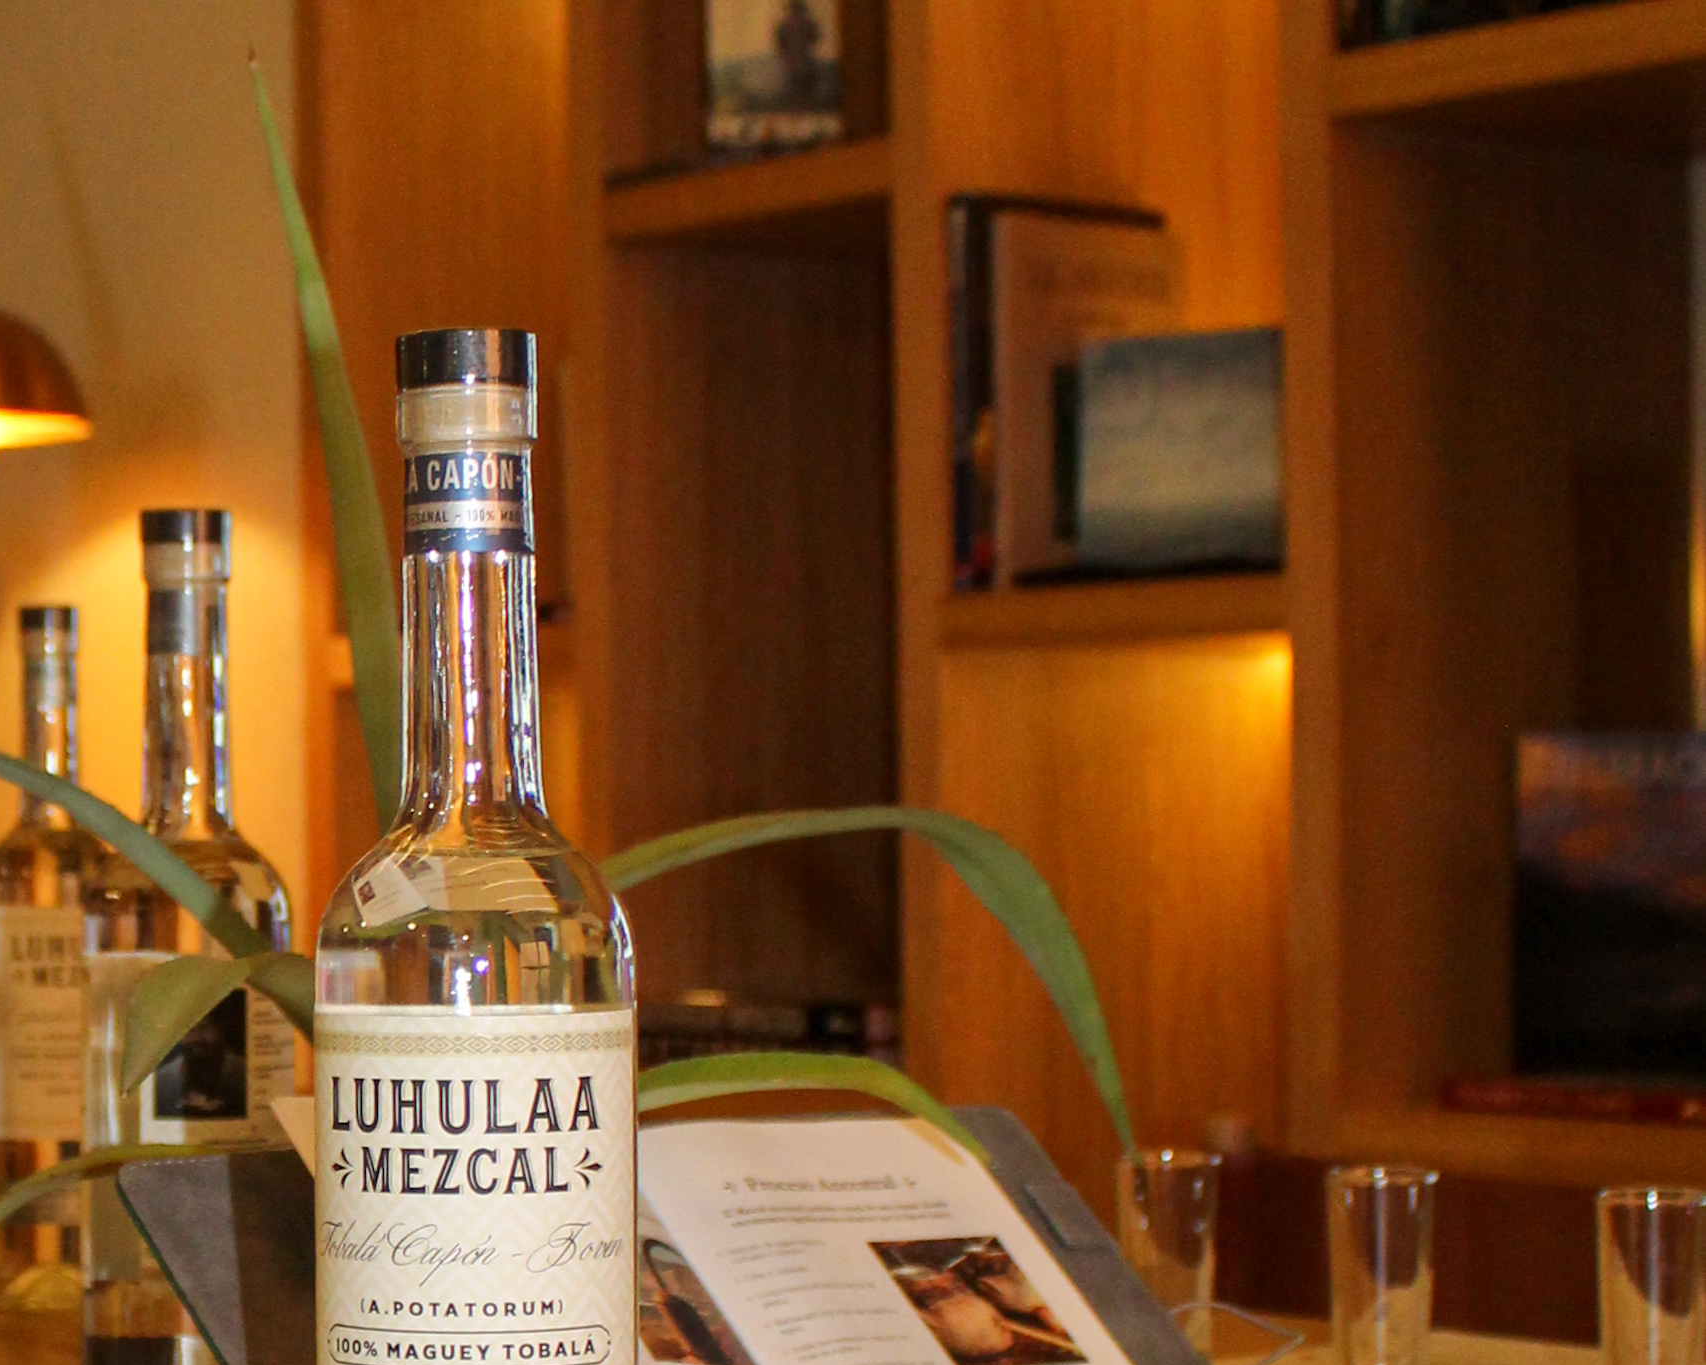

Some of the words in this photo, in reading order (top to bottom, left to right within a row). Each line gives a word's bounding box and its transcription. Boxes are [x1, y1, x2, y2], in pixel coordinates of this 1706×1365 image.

[427, 452, 514, 491] CAPÓN
[406, 511, 448, 526] ESANAL
[467, 509, 495, 522] 100%
[500, 510, 522, 523] MAG
[331, 1075, 600, 1135] LUHULAA
[360, 1146, 570, 1195] MEZCAL
[318, 1220, 387, 1263] Tobalá
[386, 1222, 501, 1288] Capón
[335, 1337, 378, 1358] 100%
[386, 1342, 490, 1361] MAGUEY
[502, 1333, 596, 1360] TOBALÁ
